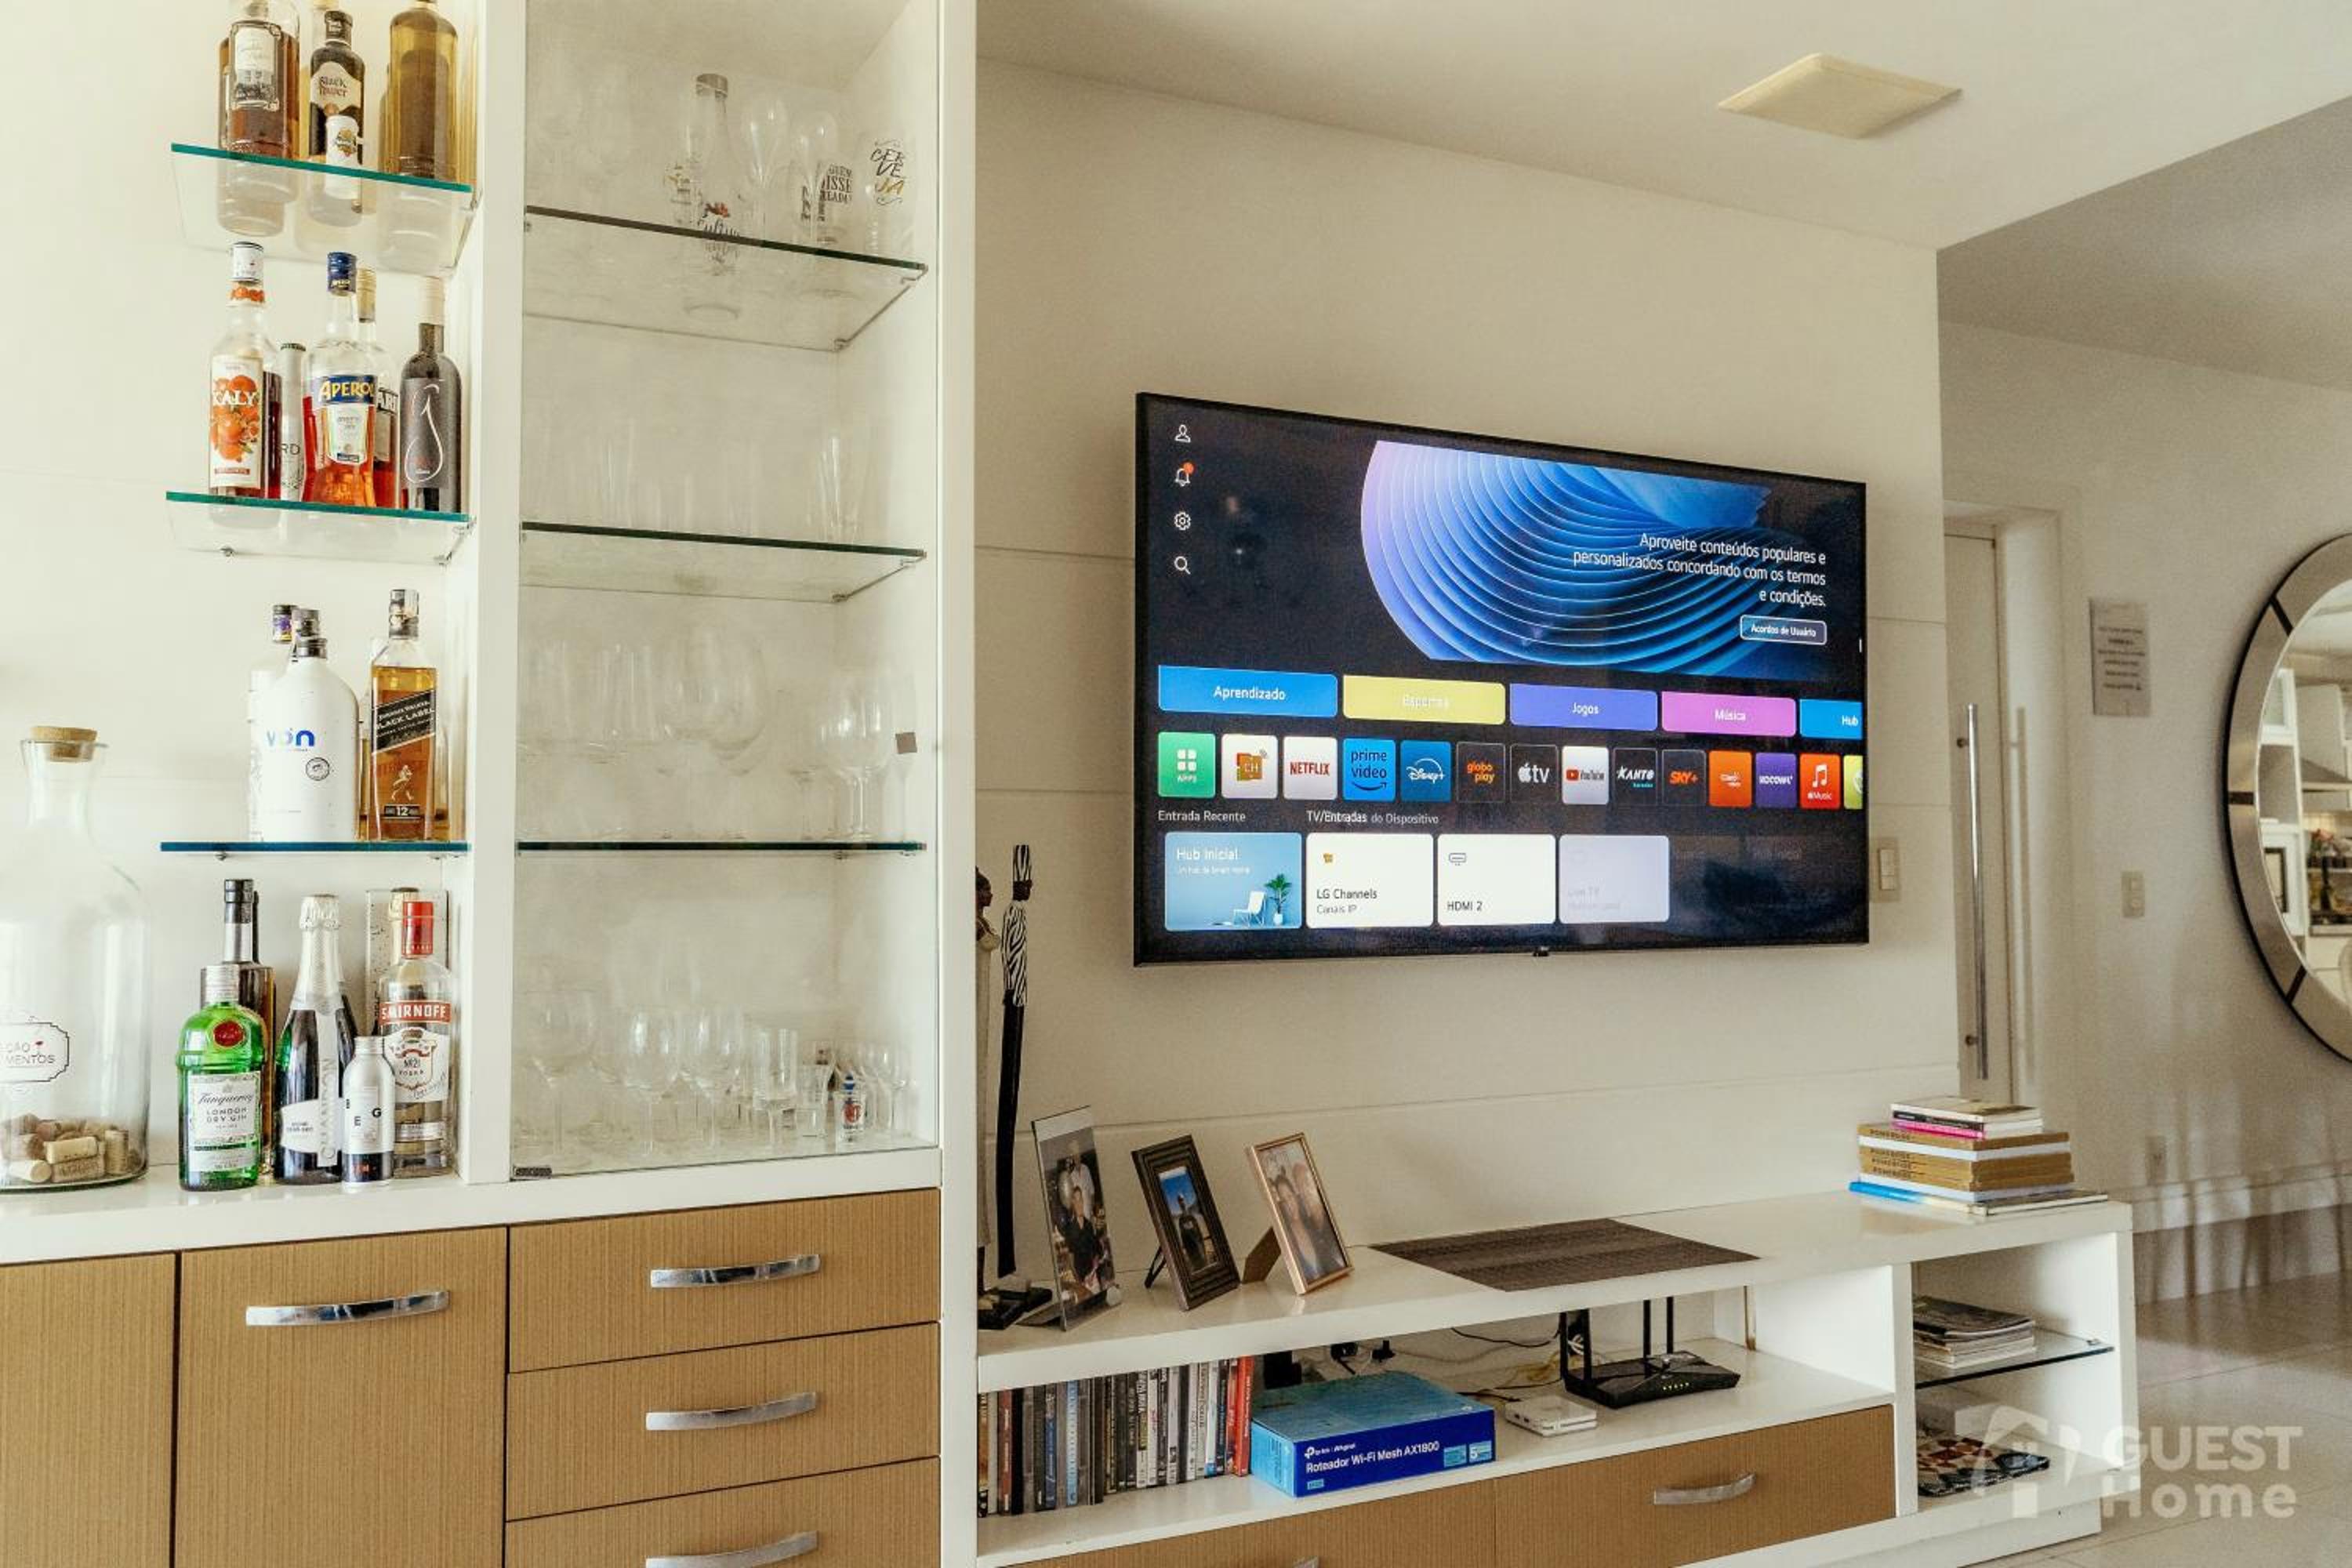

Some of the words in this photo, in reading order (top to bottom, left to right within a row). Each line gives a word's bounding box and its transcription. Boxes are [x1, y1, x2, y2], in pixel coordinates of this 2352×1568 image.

[1639, 532, 1697, 553] Aproveite
[1700, 539, 1759, 557] conteúdos
[1762, 547, 1816, 564] populares
[1818, 554, 1826, 565] e
[1573, 551, 1663, 570] personalizados
[1668, 561, 1740, 578] concordando
[1744, 568, 1767, 580] com
[1772, 571, 1784, 582] os
[1787, 570, 1826, 586] termos
[1759, 591, 1766, 601] e
[1769, 590, 1826, 608] condições.
[1751, 624, 1779, 636] Acordos
[1780, 625, 1790, 636] de
[1791, 625, 1817, 638] Usuário
[1214, 686, 1286, 702] Aprendizado
[1572, 702, 1599, 716] Jogos
[1715, 709, 1746, 722] Música
[1842, 715, 1858, 727] Hub
[1351, 750, 1387, 766] prime
[1290, 761, 1330, 776] NETFLIX
[1352, 764, 1387, 779] video
[1406, 763, 1445, 783] Disney+
[1467, 760, 1494, 774] globo
[1533, 764, 1550, 783] tv
[1474, 771, 1495, 785] play
[1580, 769, 1605, 782] YouTube
[1670, 771, 1698, 783] SKY+
[395, 806, 408, 816] 12
[1157, 811, 1200, 822] Entrada
[1203, 811, 1246, 823] Recente
[1307, 811, 1367, 824] TV/Entradas
[1385, 814, 1439, 826] Dispositivo
[1177, 848, 1200, 861] Hub
[1316, 888, 1330, 900] LG
[1334, 888, 1377, 901] Channels
[1316, 904, 1345, 915] Canais
[1447, 901, 1473, 912] HDMI
[1475, 901, 1483, 912] 2
[381, 1004, 447, 1018] SMIRNOFF
[206, 1106, 247, 1116] LONDON
[1306, 1457, 1348, 1473] Roteador
[1352, 1452, 1376, 1465] Wi-Fi
[1377, 1449, 1402, 1461] Mesh
[1403, 1441, 1440, 1456] AX1800
